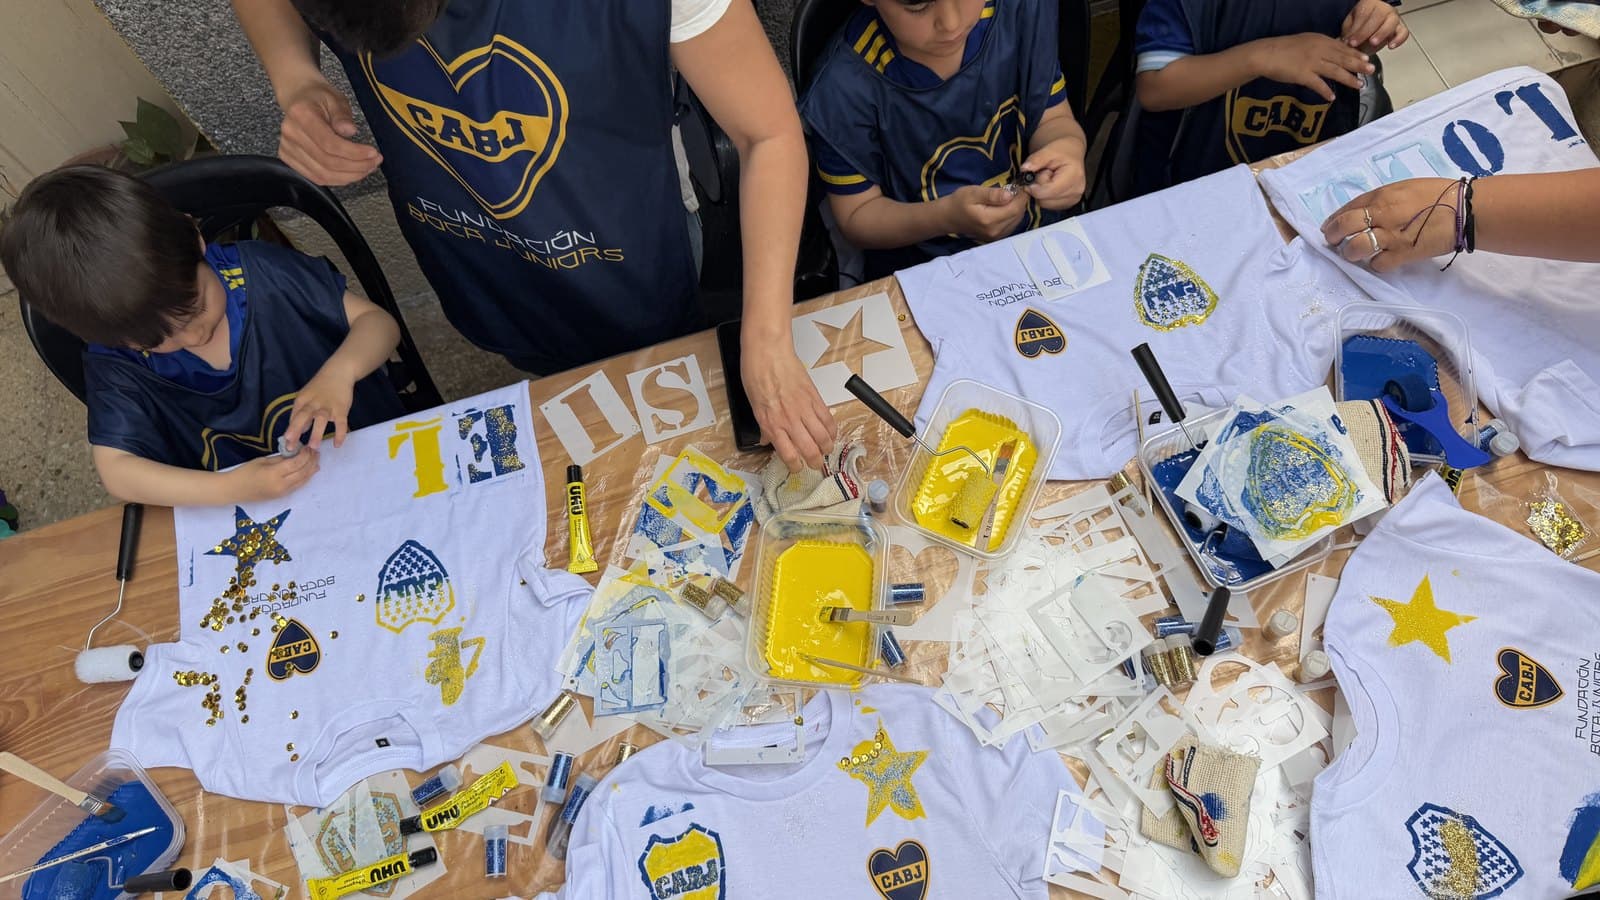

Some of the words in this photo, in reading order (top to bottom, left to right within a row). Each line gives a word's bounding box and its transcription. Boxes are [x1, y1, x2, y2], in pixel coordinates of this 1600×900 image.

[406, 103, 525, 157] CABJ
[1244, 100, 1325, 138] CABJ
[407, 202, 486, 244] BOCA
[495, 238, 625, 270] JUNIORS
[416, 196, 596, 255] FUNDACIÓN
[989, 289, 1042, 307] NDACIÓN
[1020, 327, 1055, 341] CABJ
[569, 485, 583, 516] UHU
[299, 575, 336, 592] BOCA
[1519, 660, 1535, 702] CABJ
[1575, 657, 1590, 740] FUNDACIÓN
[426, 804, 461, 830] UHU
[369, 860, 407, 883] UHU
[654, 858, 719, 900] CABJ
[881, 864, 923, 889] CABJ
